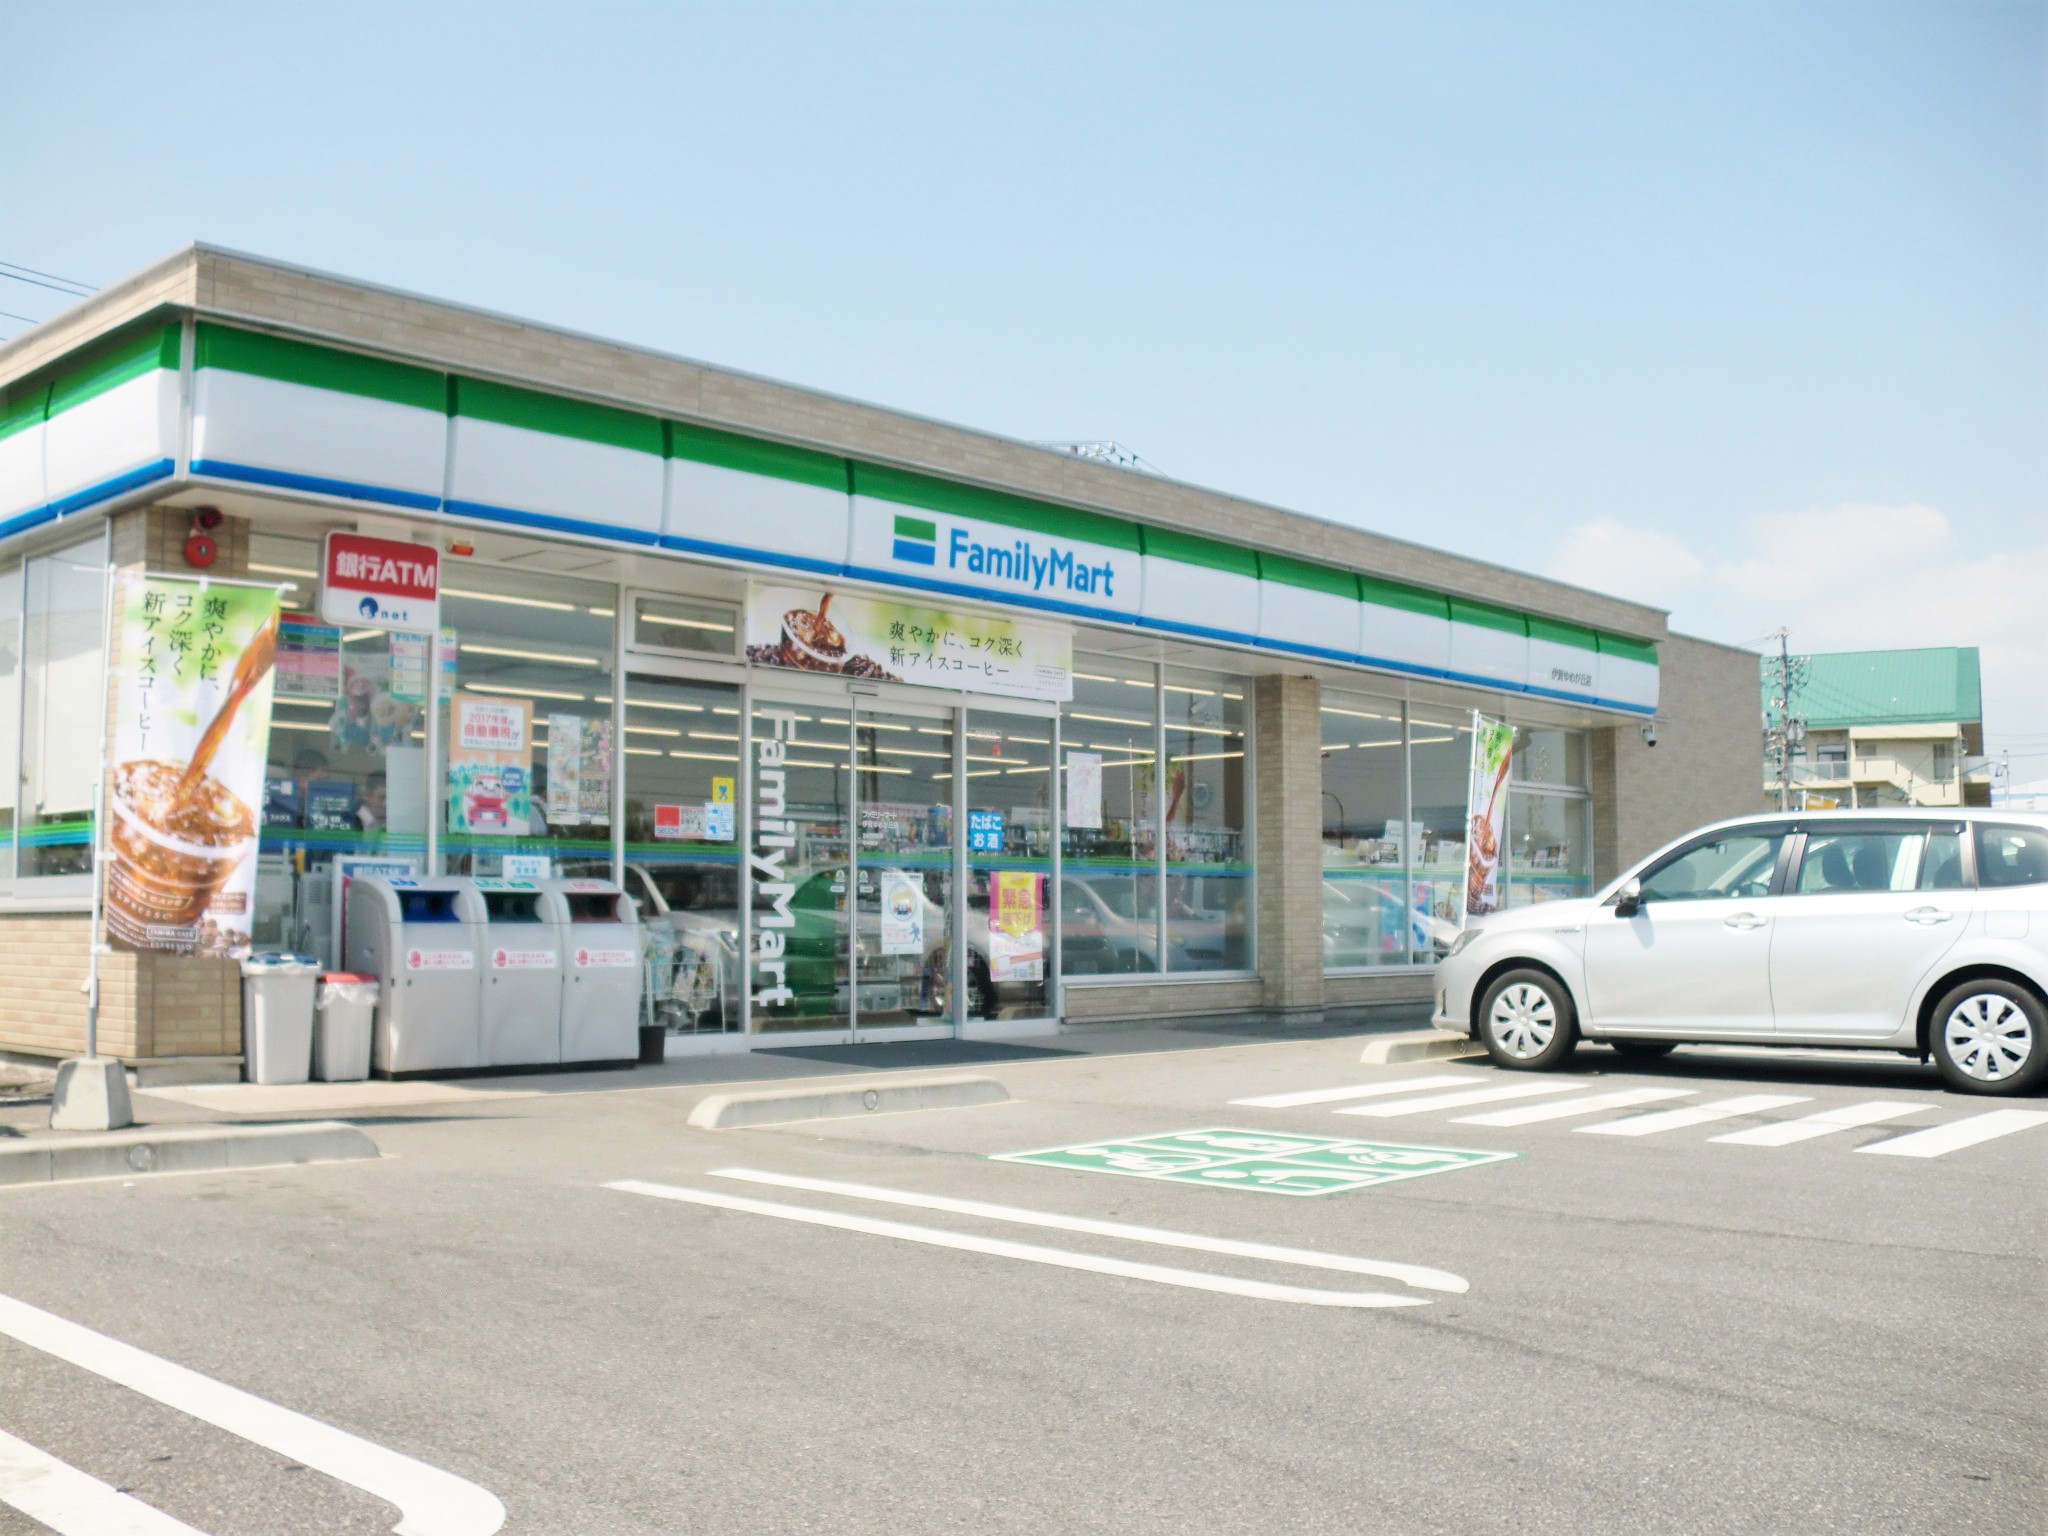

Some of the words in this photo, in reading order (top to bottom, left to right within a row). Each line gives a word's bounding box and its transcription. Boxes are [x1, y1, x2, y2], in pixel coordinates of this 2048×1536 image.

[335, 551, 435, 589] 銀行ATM
[949, 527, 1114, 597] FamilyMart
[170, 594, 194, 676] コク深く
[200, 596, 228, 691] 爽やかに、
[889, 620, 1023, 658] 爽やかに、コク深く
[138, 591, 167, 751] 新アイスコーヒー
[889, 645, 1010, 677] 新アイスコーヒー
[970, 814, 1002, 830] たばこ
[974, 833, 999, 849] お酒
[750, 708, 796, 1006] FamilyMart
[1002, 888, 1032, 909] 緊急
